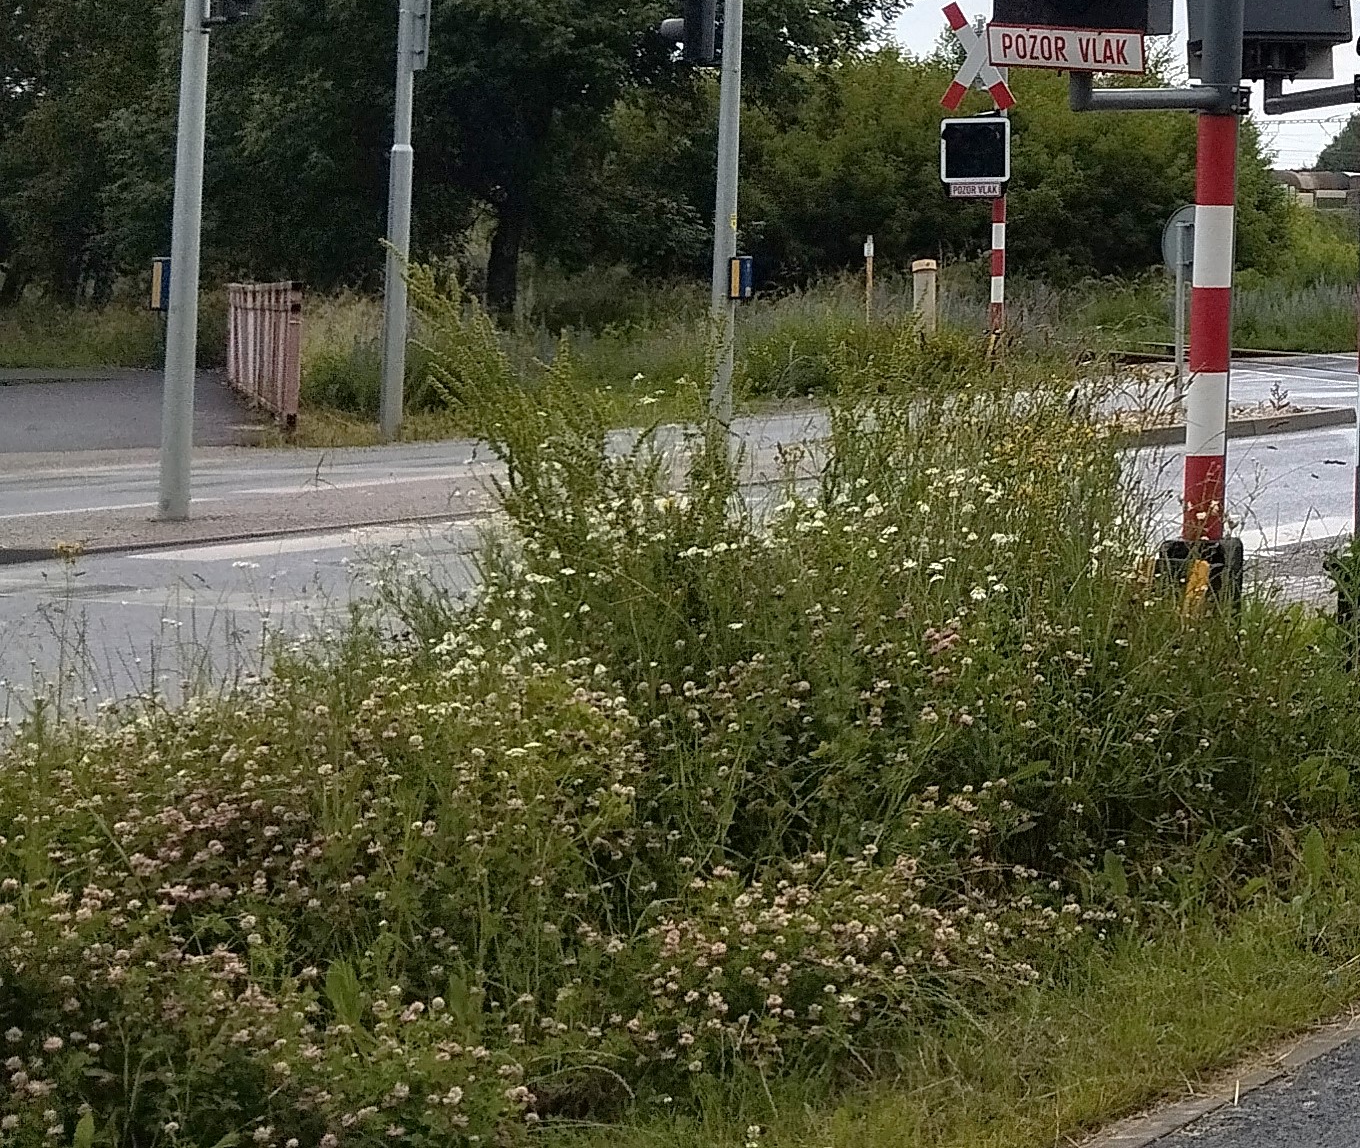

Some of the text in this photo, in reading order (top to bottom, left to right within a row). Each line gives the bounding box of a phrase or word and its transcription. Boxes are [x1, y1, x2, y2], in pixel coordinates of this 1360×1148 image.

[1002, 33, 1129, 65] POZOR VLAK
[953, 185, 998, 194] POZOR VLAK
